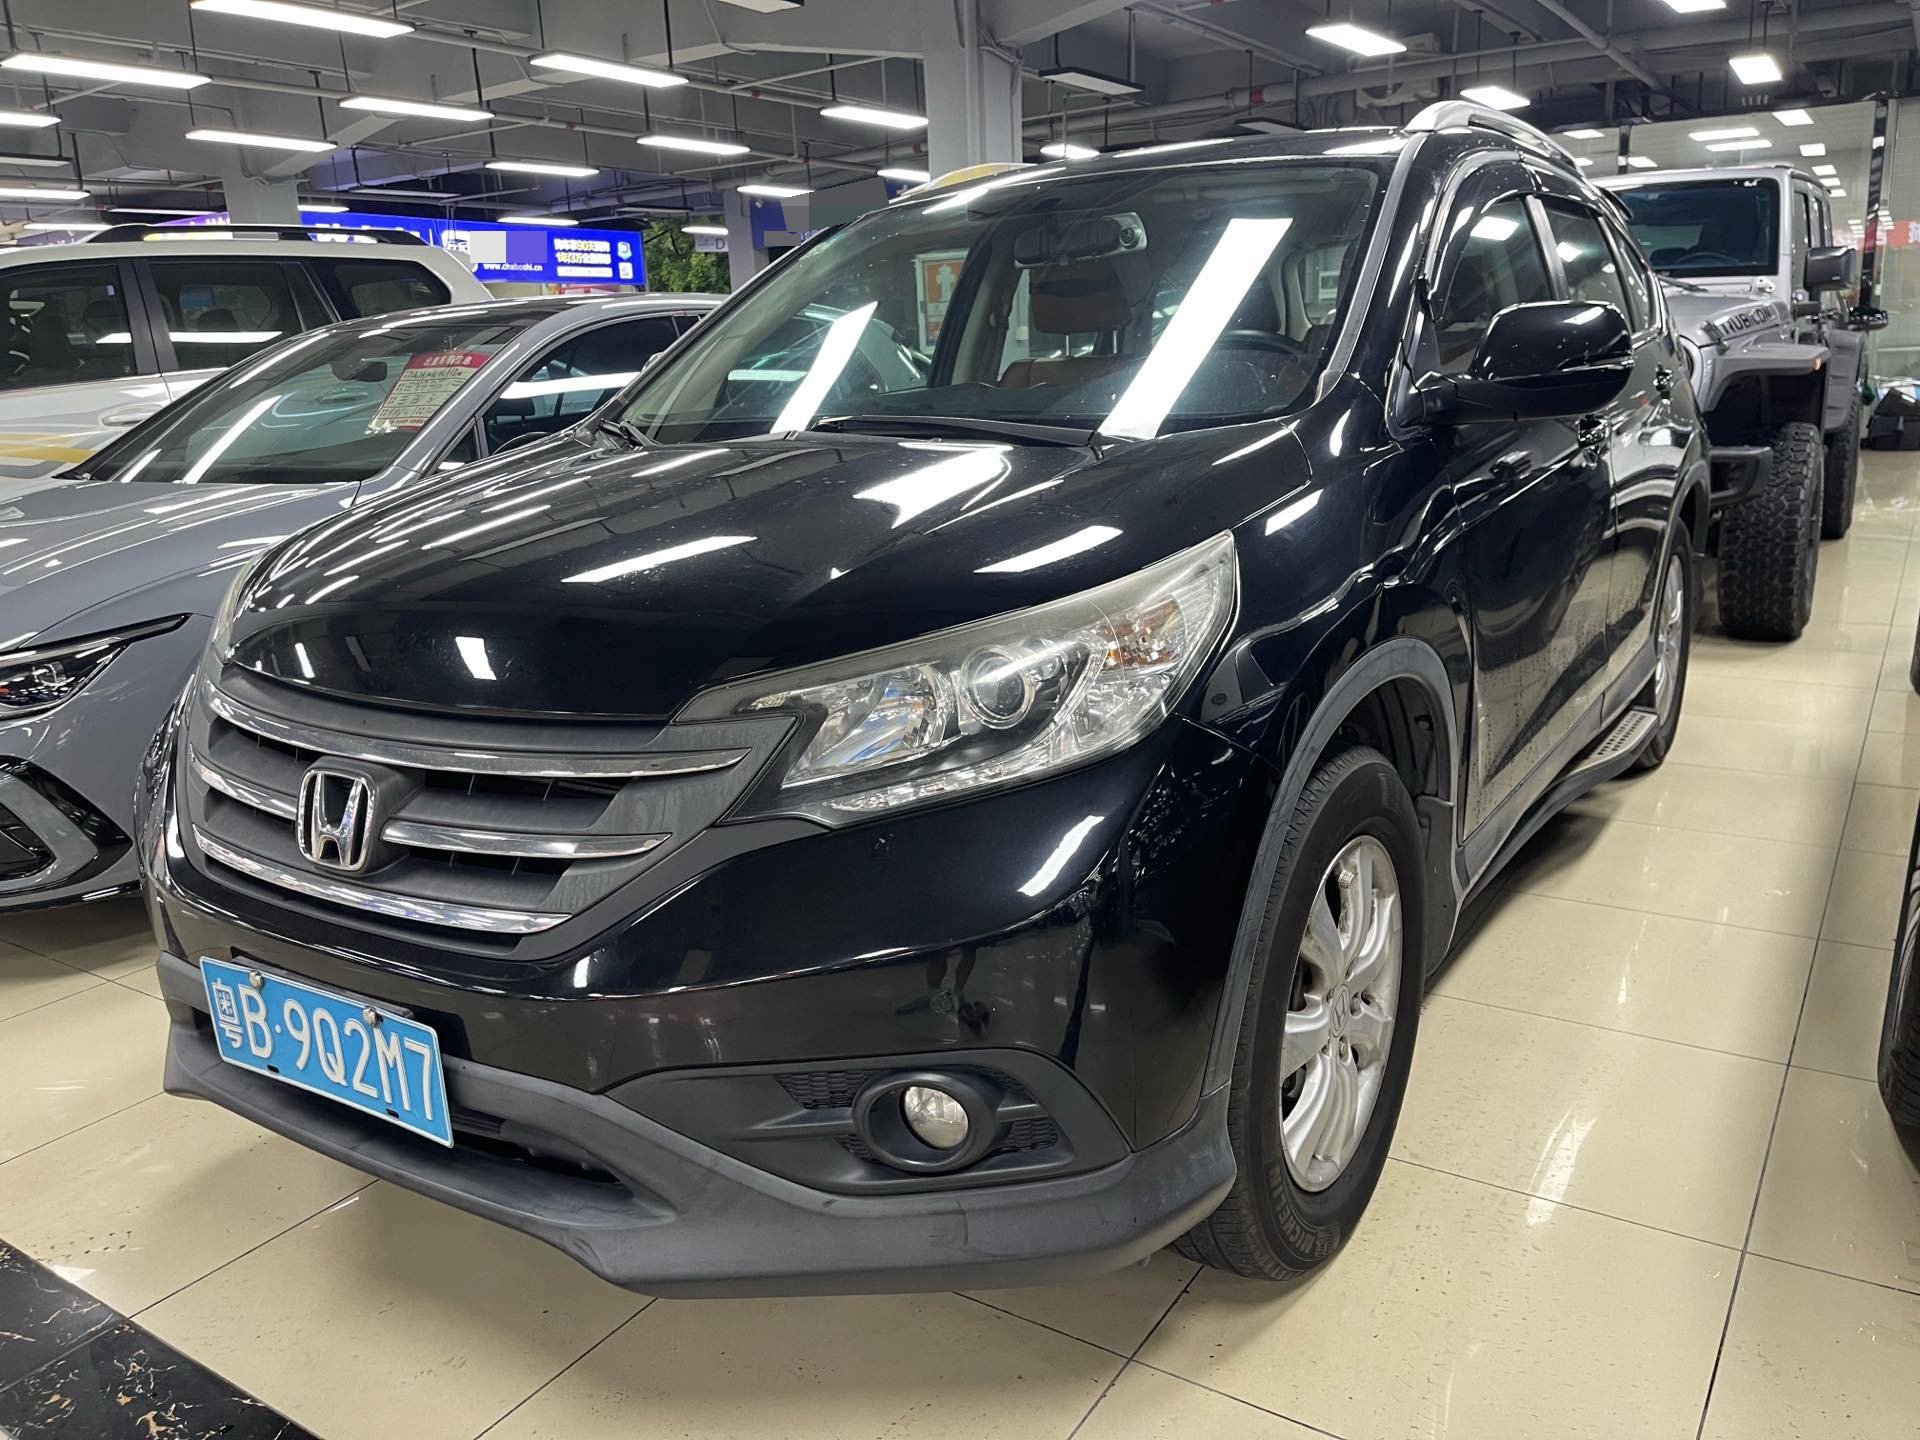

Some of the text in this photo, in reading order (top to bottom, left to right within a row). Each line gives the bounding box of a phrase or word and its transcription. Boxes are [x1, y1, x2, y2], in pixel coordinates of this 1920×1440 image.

[483, 262, 543, 272] www.chaboshi.cn
[1720, 307, 1772, 335] RUBICON
[1268, 1164, 1317, 1254] MICHELIN
